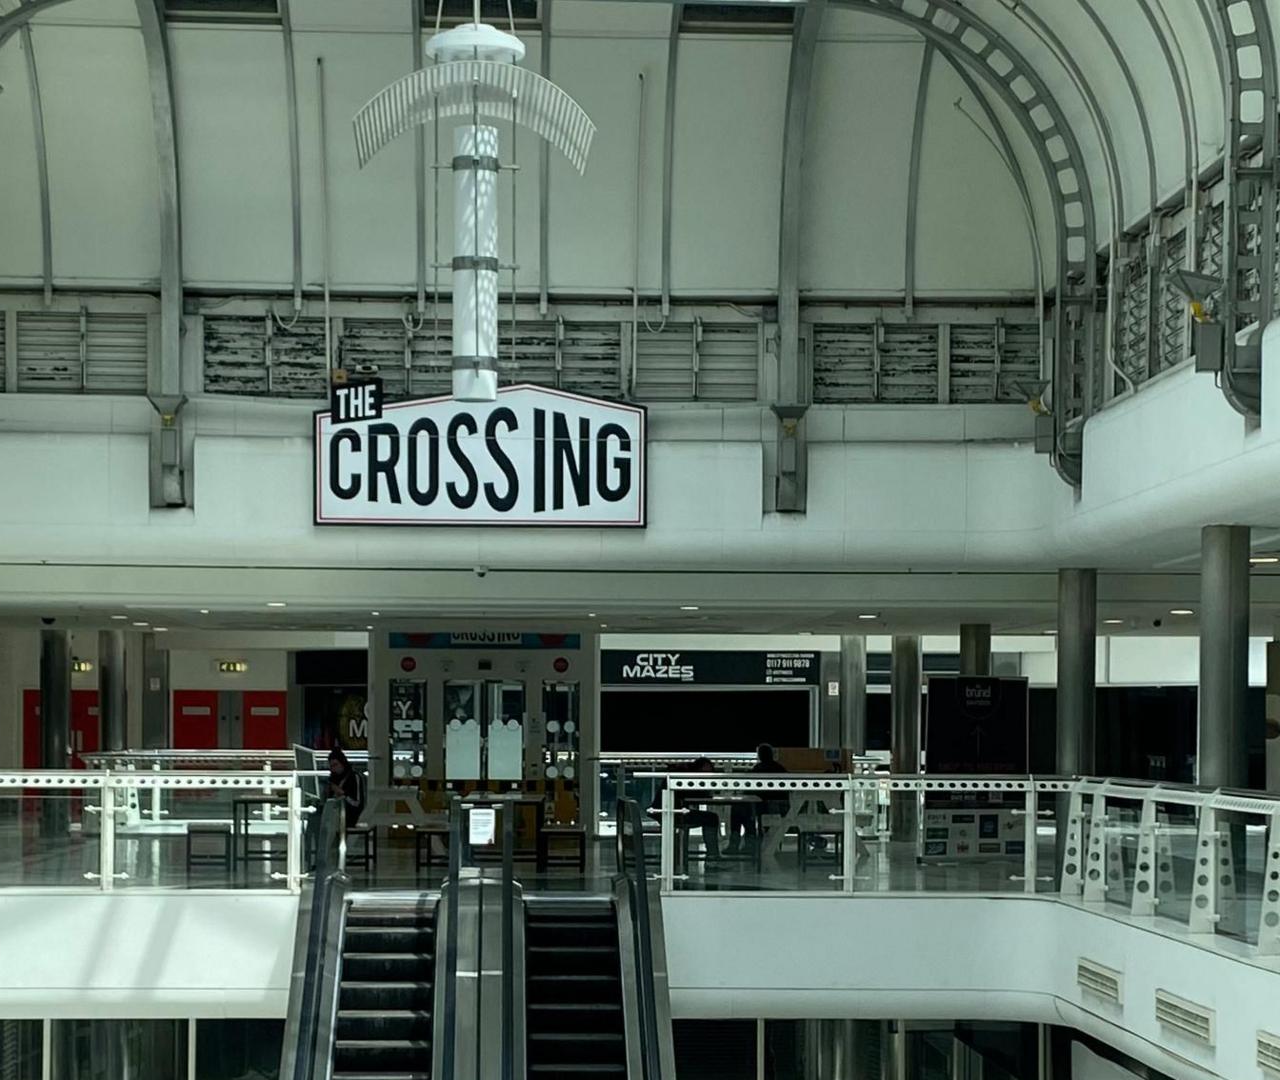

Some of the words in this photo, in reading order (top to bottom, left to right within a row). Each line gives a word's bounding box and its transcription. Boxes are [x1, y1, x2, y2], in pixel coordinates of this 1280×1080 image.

[335, 385, 377, 419] THE
[330, 406, 631, 513] CROSSING
[636, 653, 680, 666] CITY
[766, 659, 780, 668] 0117
[782, 659, 792, 668] 911
[623, 665, 695, 678] MAZES
